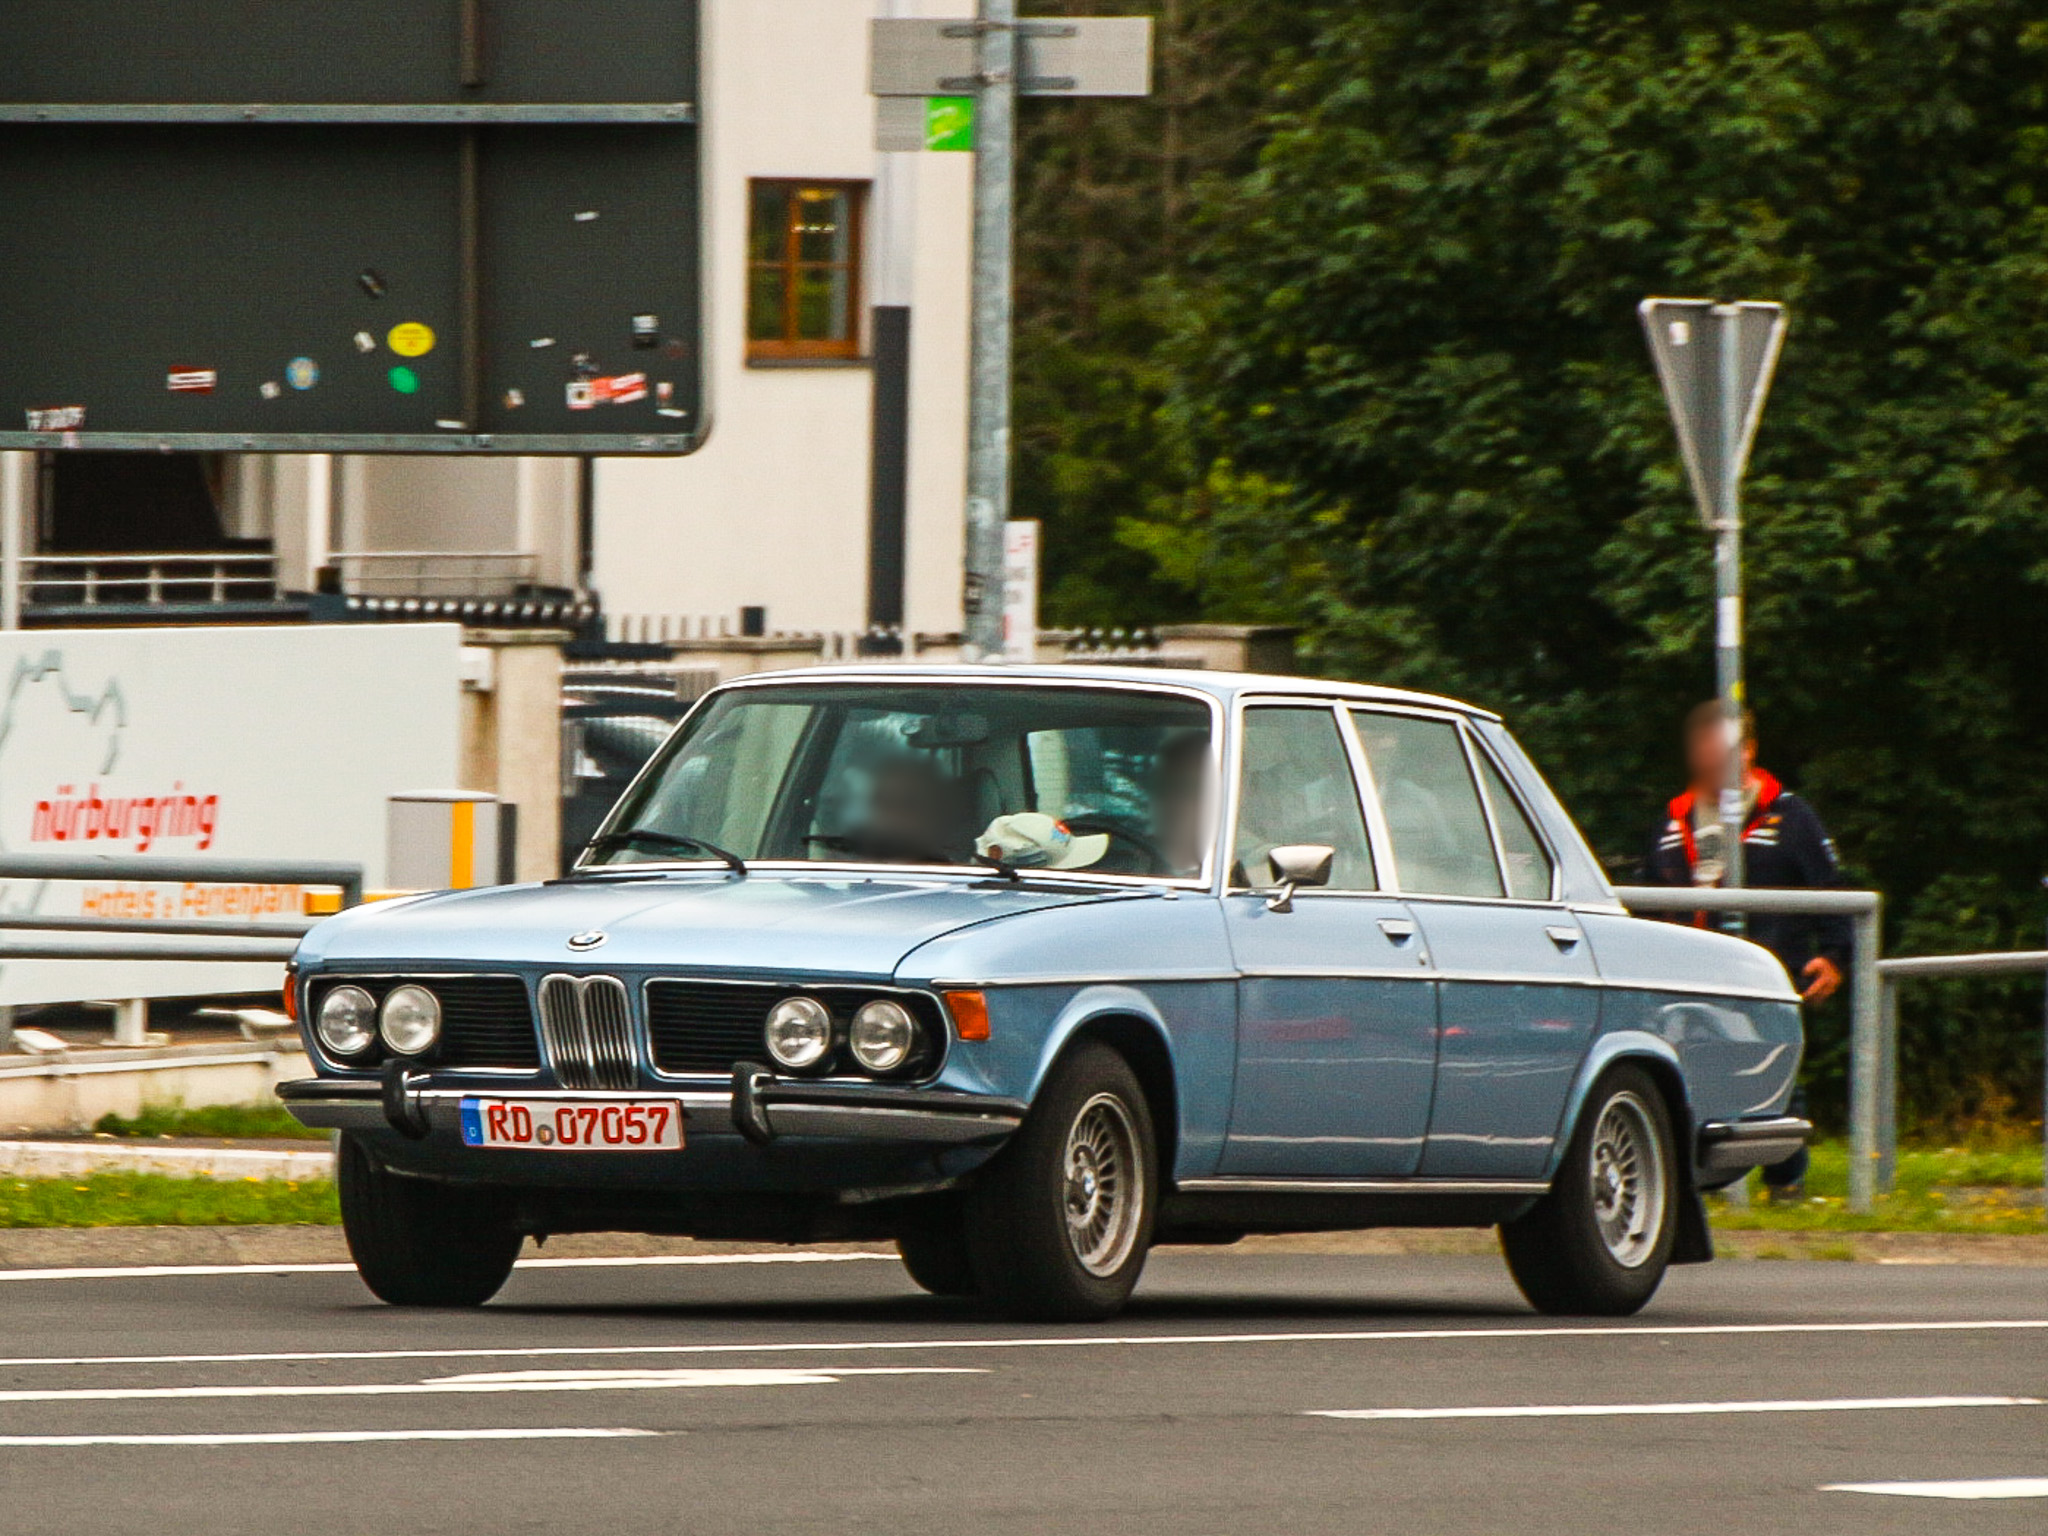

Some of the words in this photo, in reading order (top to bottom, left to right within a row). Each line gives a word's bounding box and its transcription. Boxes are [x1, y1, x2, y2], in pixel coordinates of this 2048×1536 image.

[31, 781, 219, 852] nürburgring
[488, 1105, 532, 1142] RD
[555, 1107, 669, 1145] 07057
